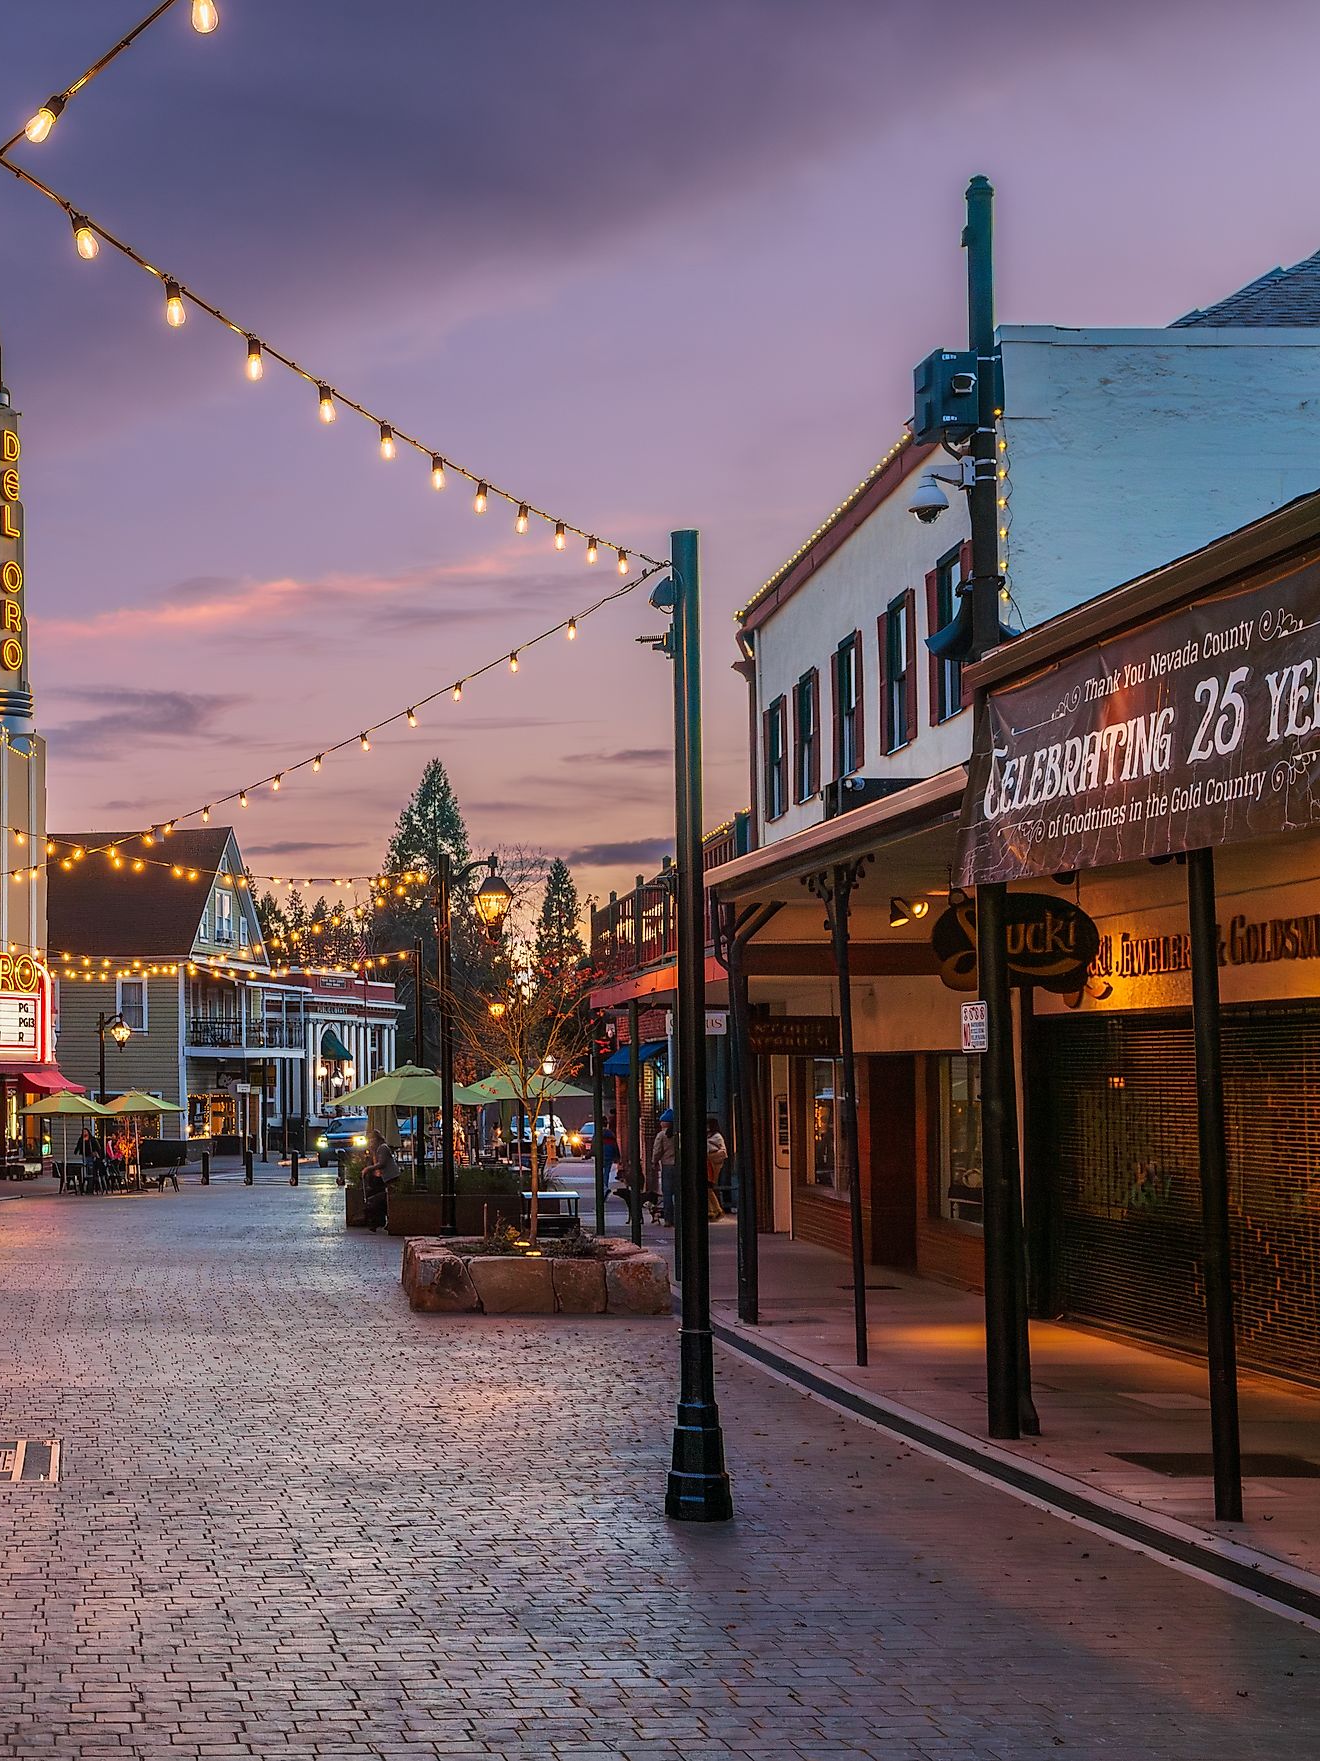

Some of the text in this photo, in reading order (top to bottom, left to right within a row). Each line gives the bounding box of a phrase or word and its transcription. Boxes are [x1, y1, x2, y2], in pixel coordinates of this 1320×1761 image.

[0, 429, 24, 672] DEL ORO
[1084, 618, 1255, 703] Thank You Nevada County
[984, 706, 1176, 821] CELEBRATING
[1186, 665, 1251, 766] 25
[1048, 770, 1267, 839] of Goodtimes in the Gold Country
[18, 1003, 29, 1013] PG
[18, 1032, 25, 1042] R
